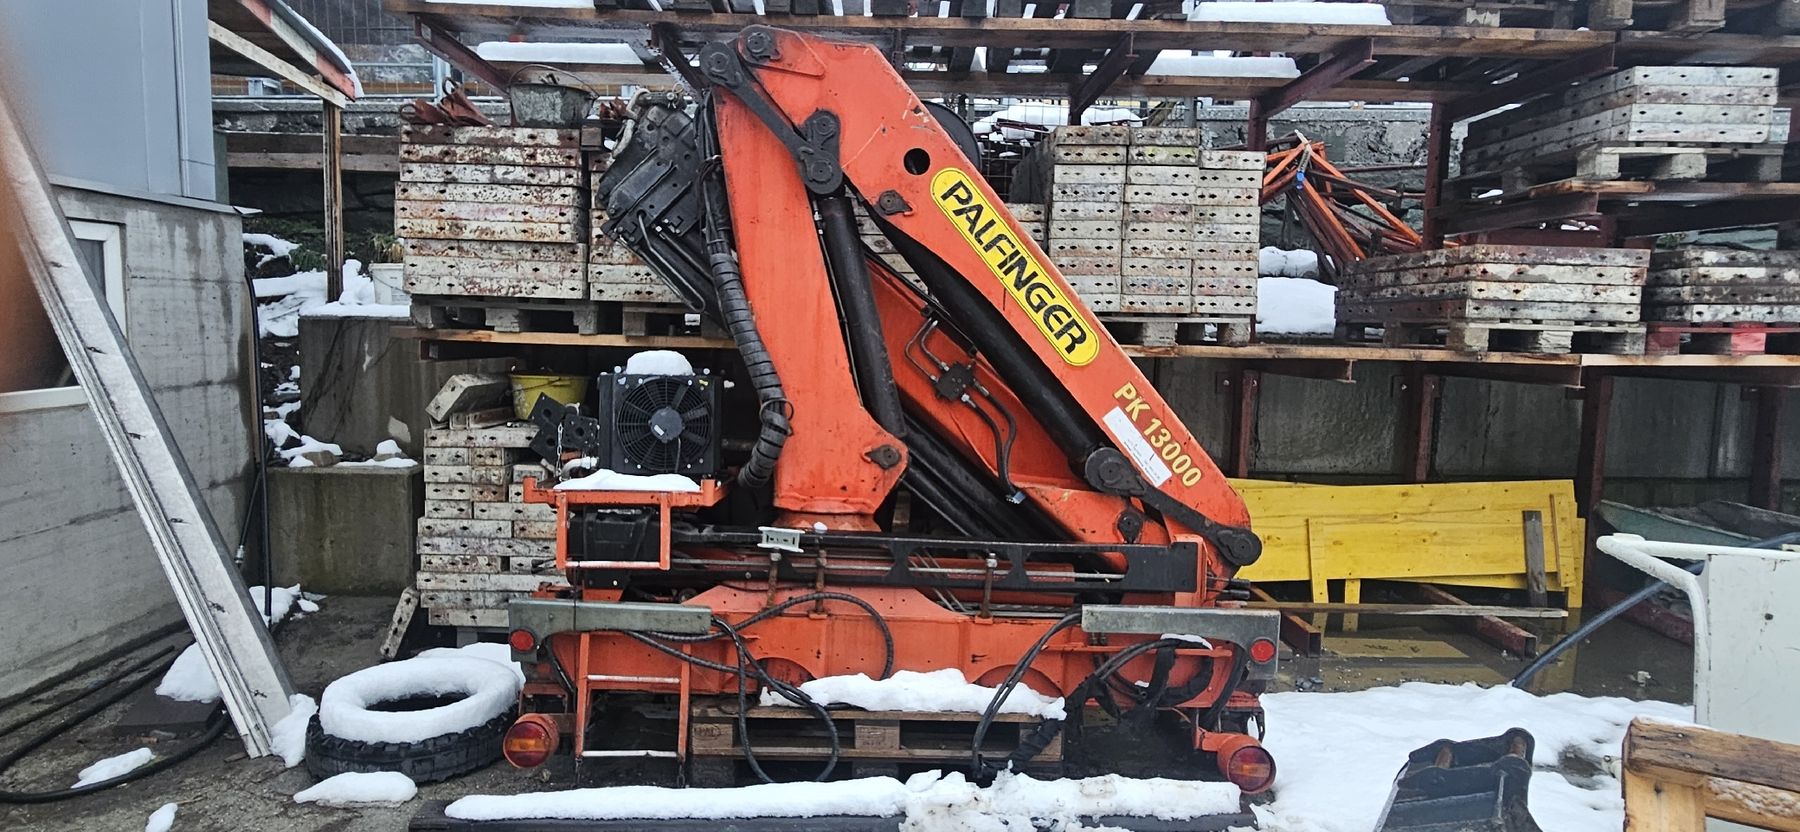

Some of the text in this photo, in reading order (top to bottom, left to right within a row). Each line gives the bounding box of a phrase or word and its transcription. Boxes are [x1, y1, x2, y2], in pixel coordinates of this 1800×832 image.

[941, 180, 1087, 354] PALFINGER
[1113, 382, 1151, 421] PK
[1143, 418, 1202, 487] 13000
